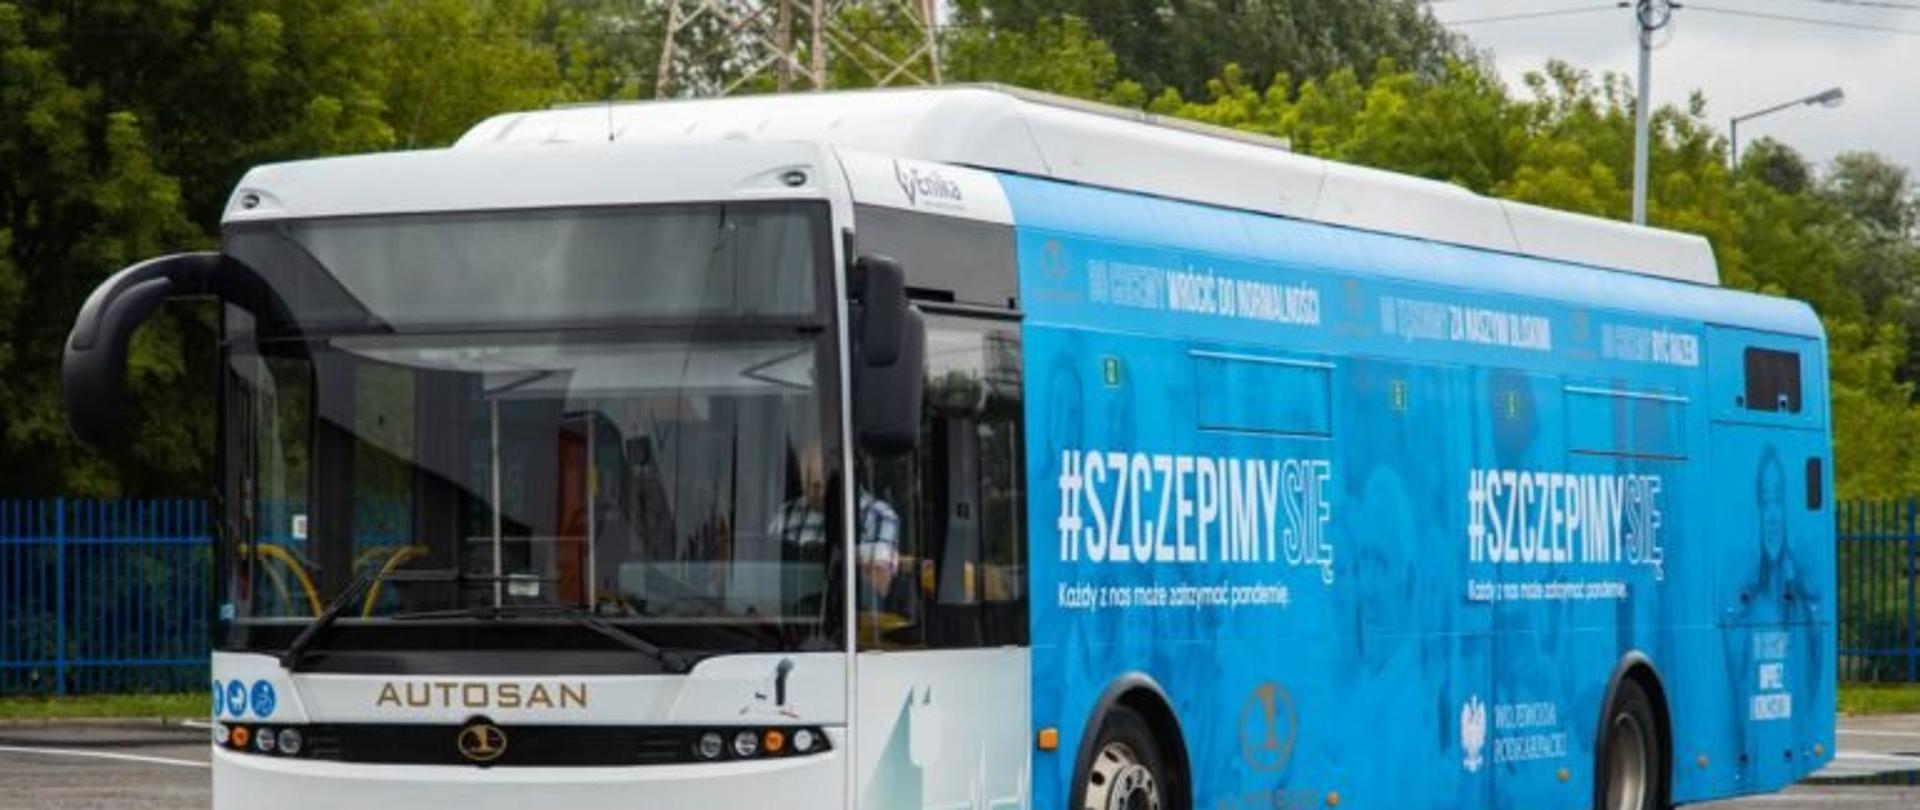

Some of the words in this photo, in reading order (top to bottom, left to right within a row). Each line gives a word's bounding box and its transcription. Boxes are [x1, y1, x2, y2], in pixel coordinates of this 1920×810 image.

[1218, 277, 1235, 318] DO
[1058, 581, 1097, 612] Każdy
[1100, 586, 1107, 607] z
[1109, 586, 1131, 607] nas
[1134, 582, 1167, 607] może
[377, 682, 588, 709] AUTOSAN
